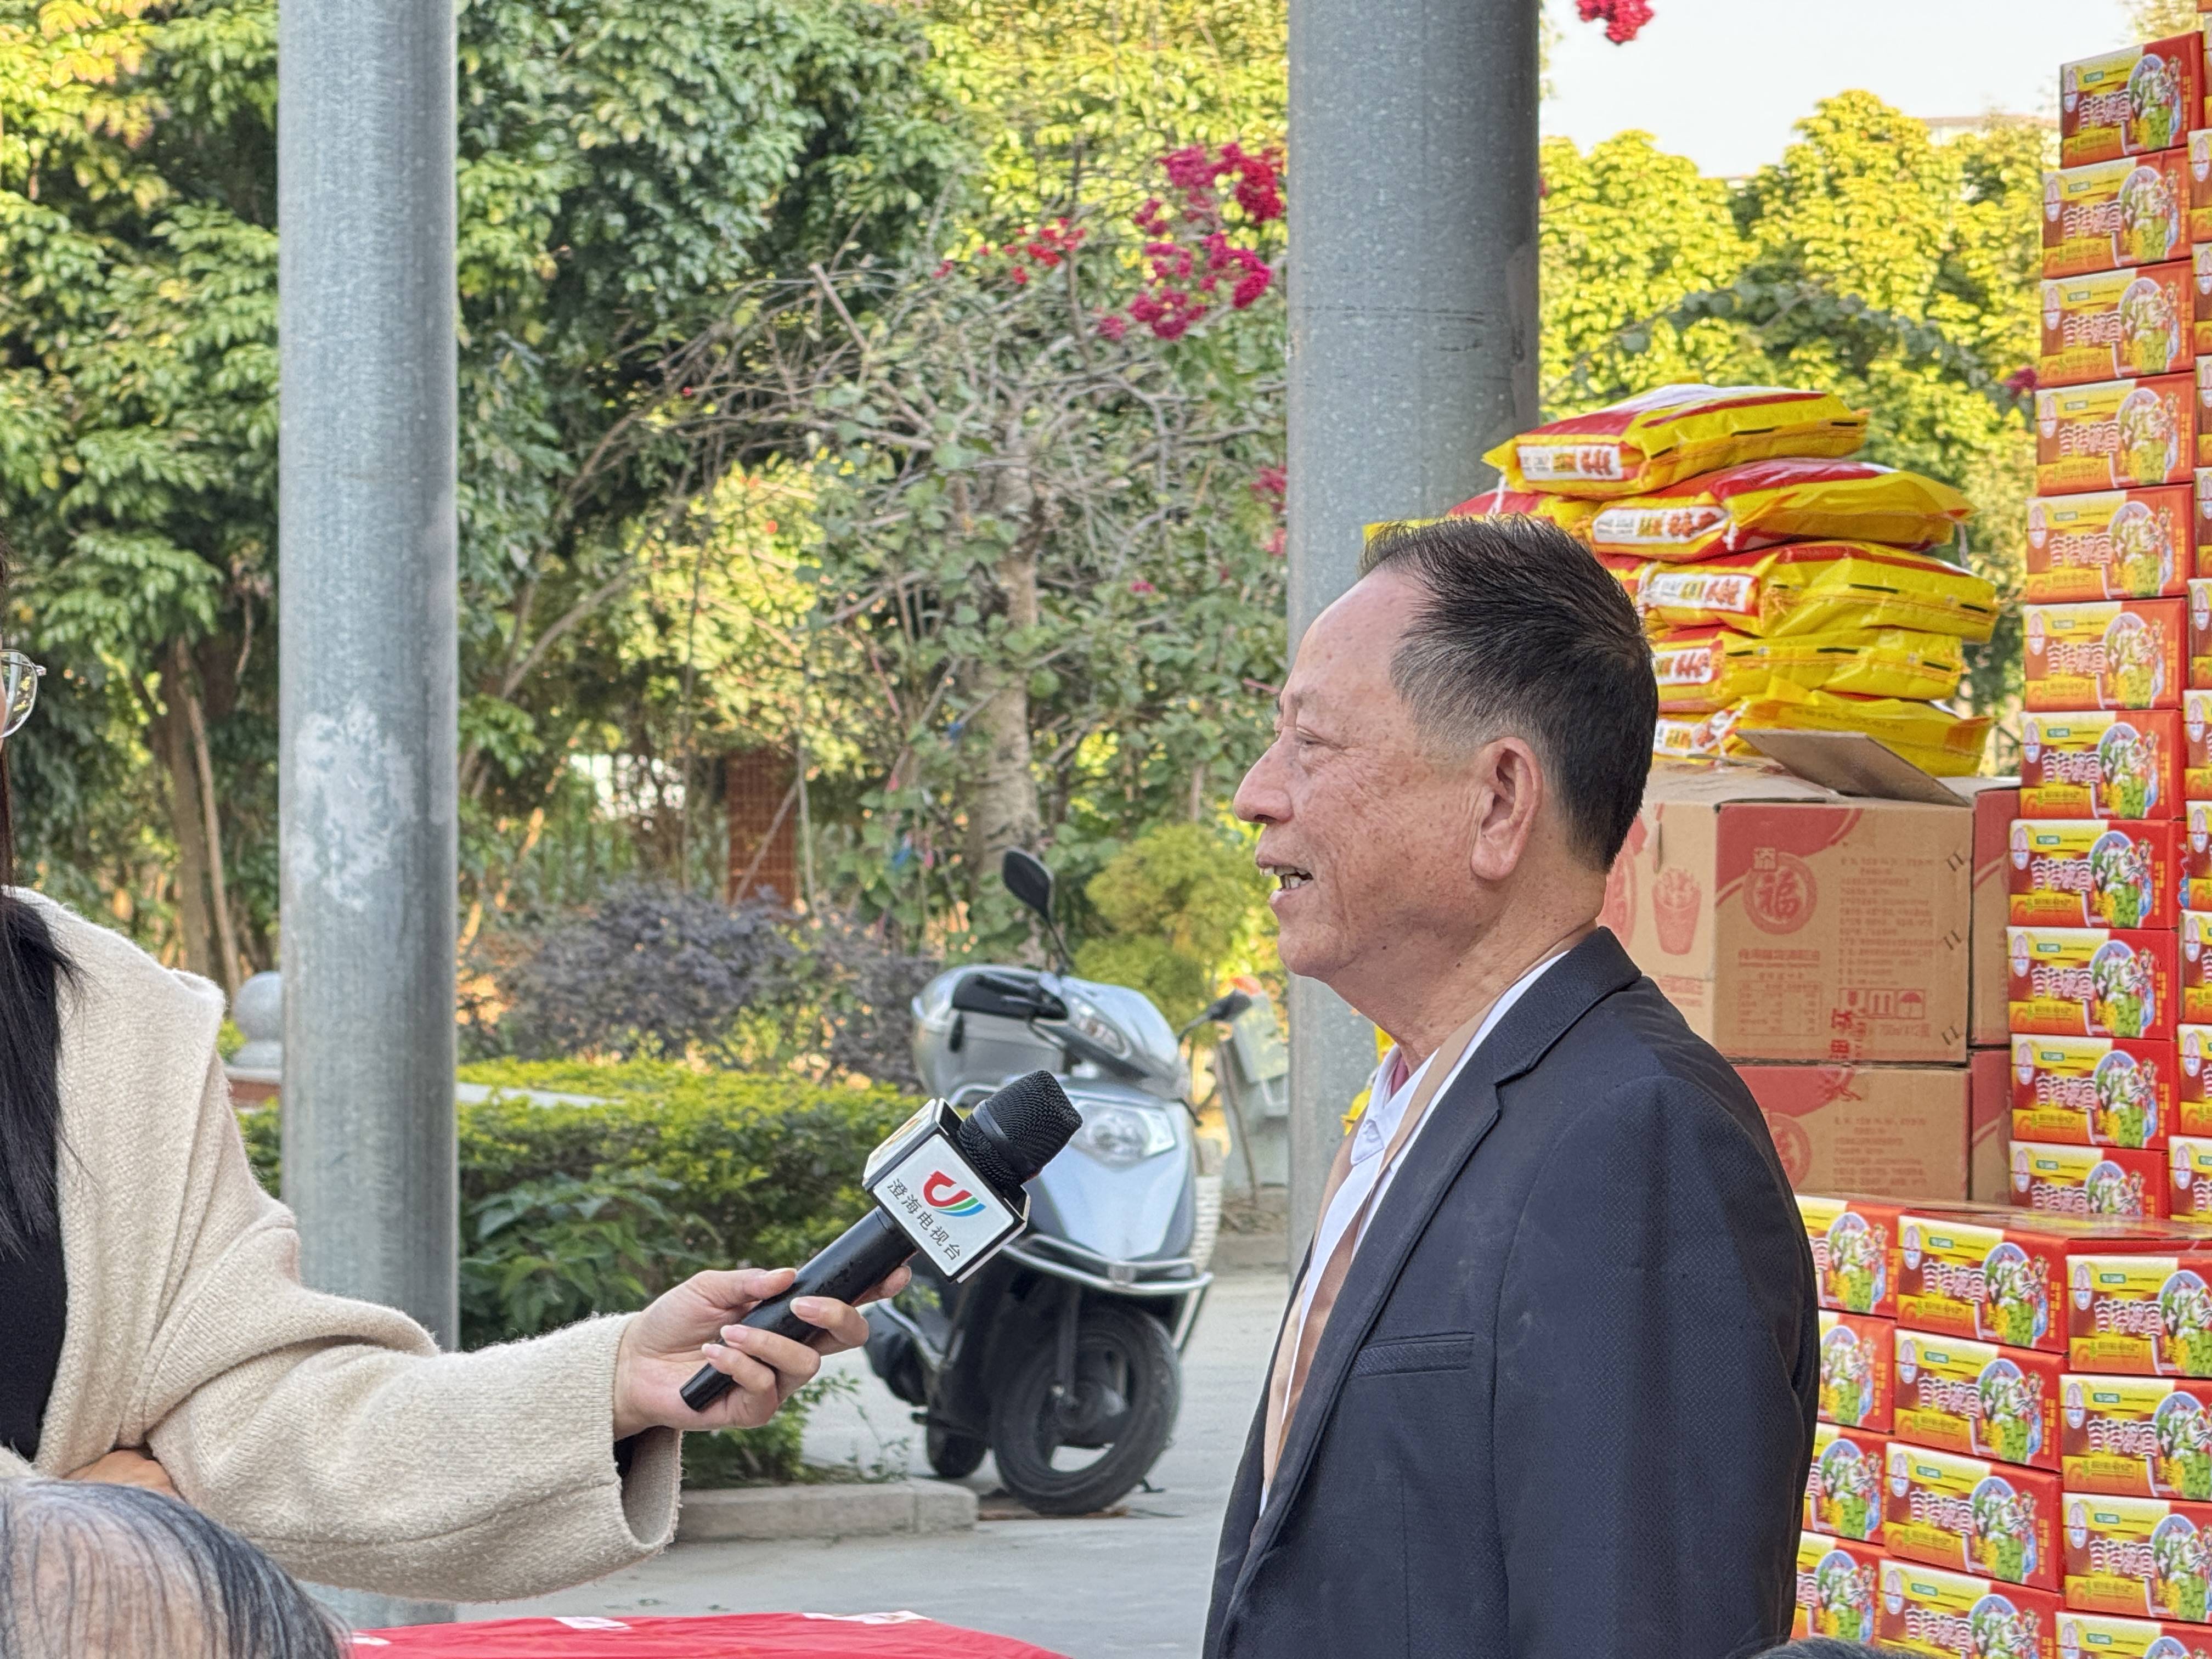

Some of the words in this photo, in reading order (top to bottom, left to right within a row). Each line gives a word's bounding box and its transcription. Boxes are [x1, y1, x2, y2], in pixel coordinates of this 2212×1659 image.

[887, 1178, 962, 1261] 澄海电视台
